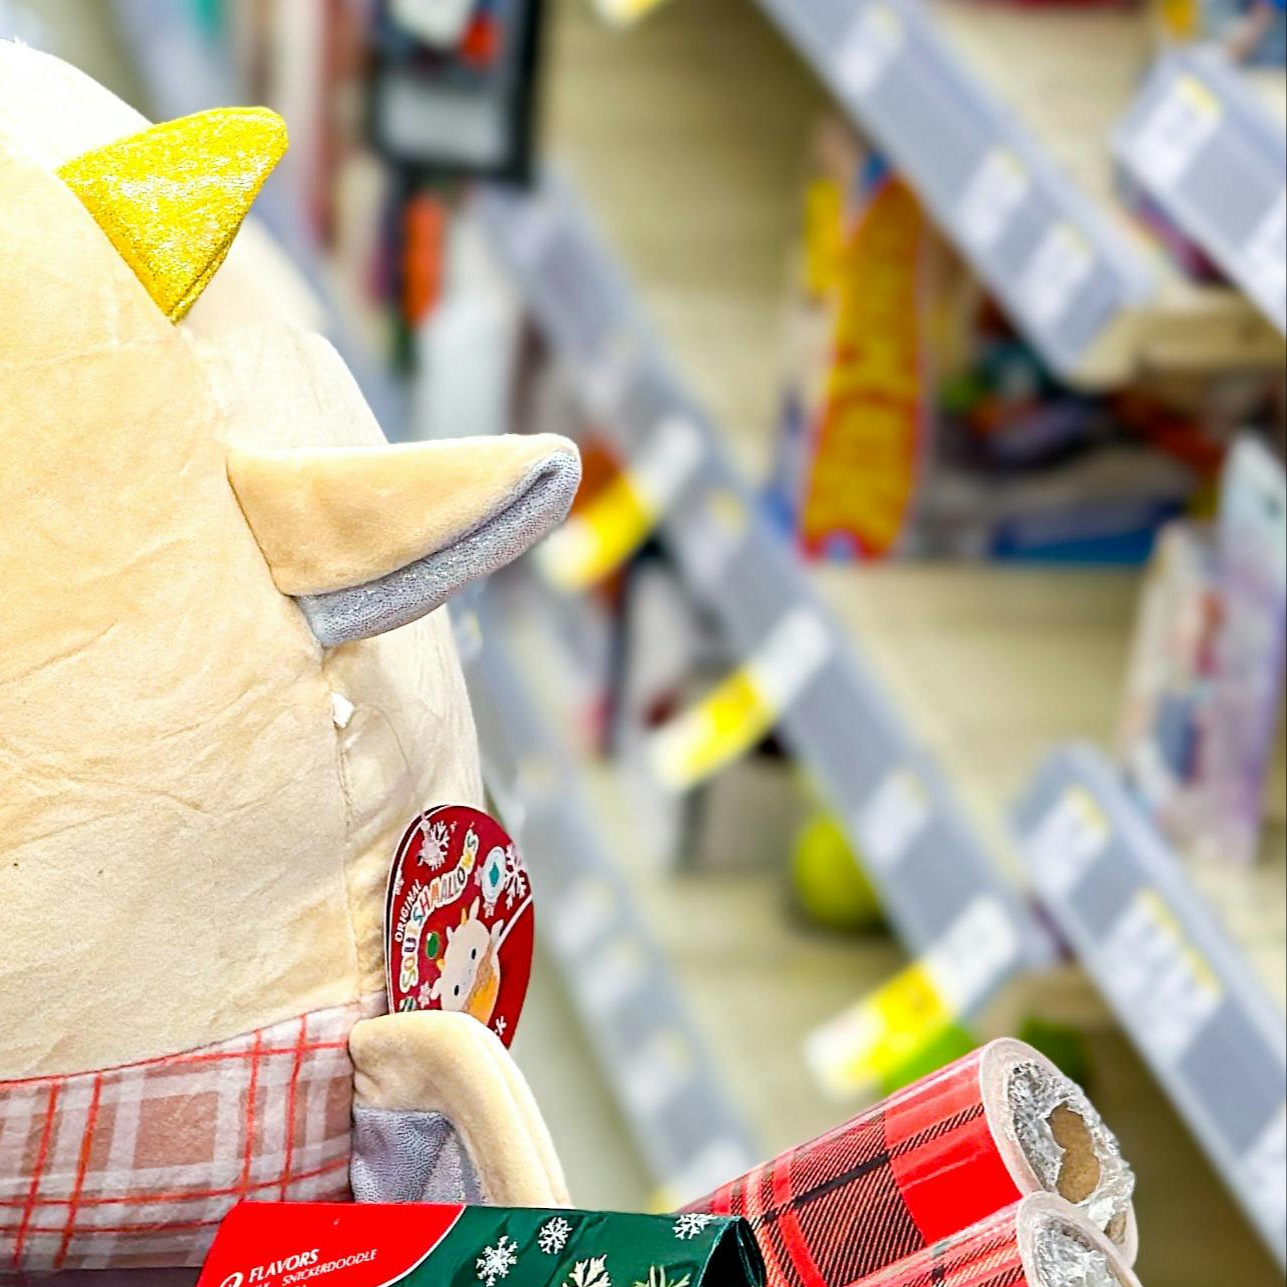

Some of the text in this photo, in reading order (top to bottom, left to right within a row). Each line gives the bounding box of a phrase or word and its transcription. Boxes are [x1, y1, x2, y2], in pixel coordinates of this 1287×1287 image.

[394, 879, 424, 944] ORIGINAL
[249, 1249, 319, 1283] FLAVORS
[282, 1249, 377, 1287] SNICKERDOODLE
